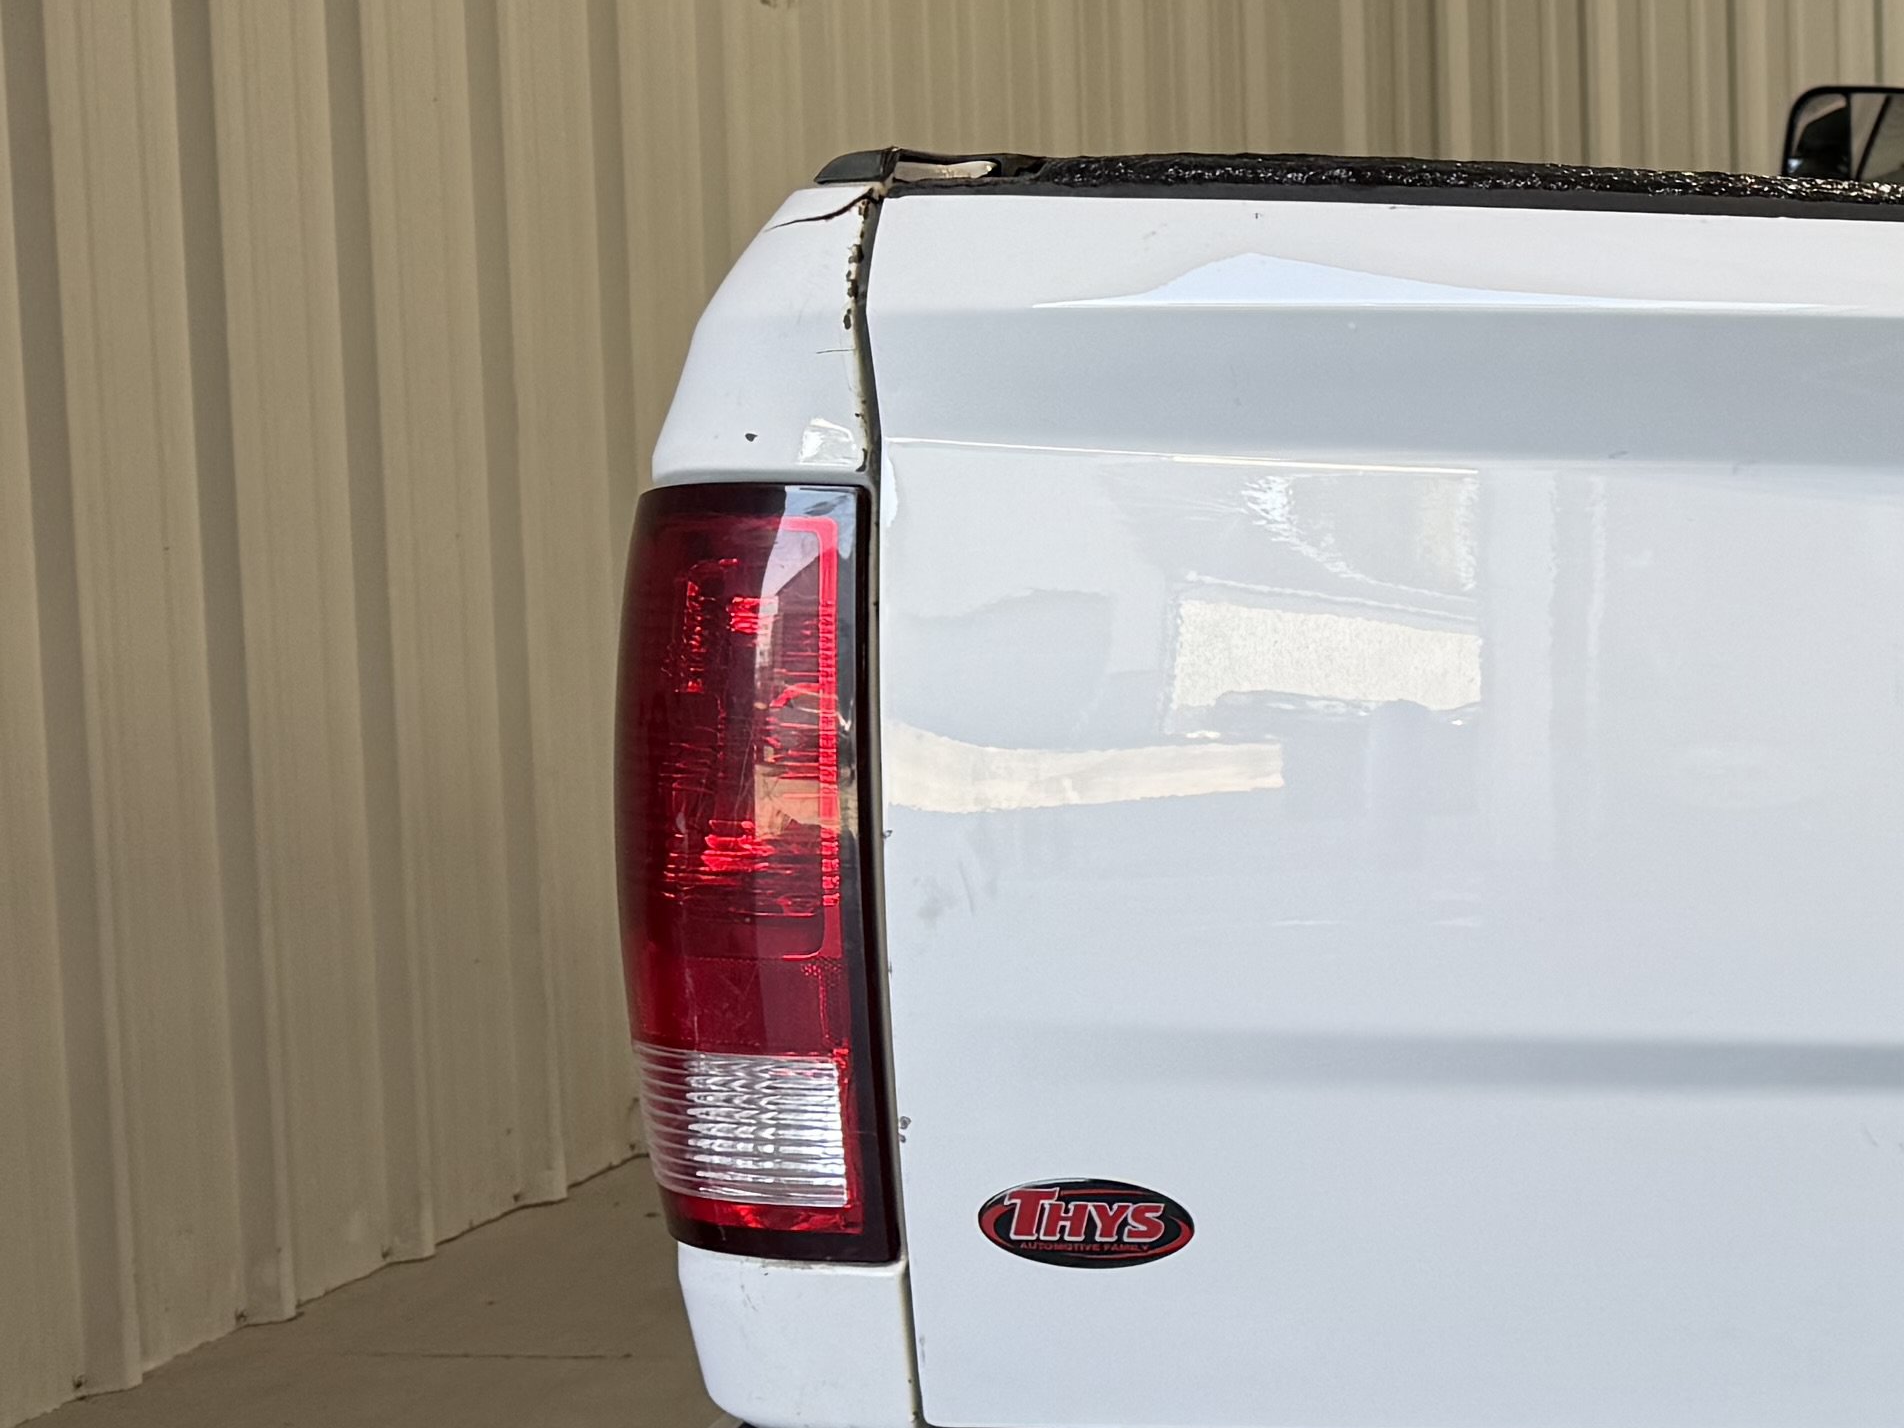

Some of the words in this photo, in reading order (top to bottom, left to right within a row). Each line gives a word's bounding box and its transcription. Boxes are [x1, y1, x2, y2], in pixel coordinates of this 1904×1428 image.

[1004, 1187, 1166, 1243] THYS
[1020, 1241, 1101, 1252] AUTOMOTIVE
[1103, 1243, 1150, 1252] FAMILY
